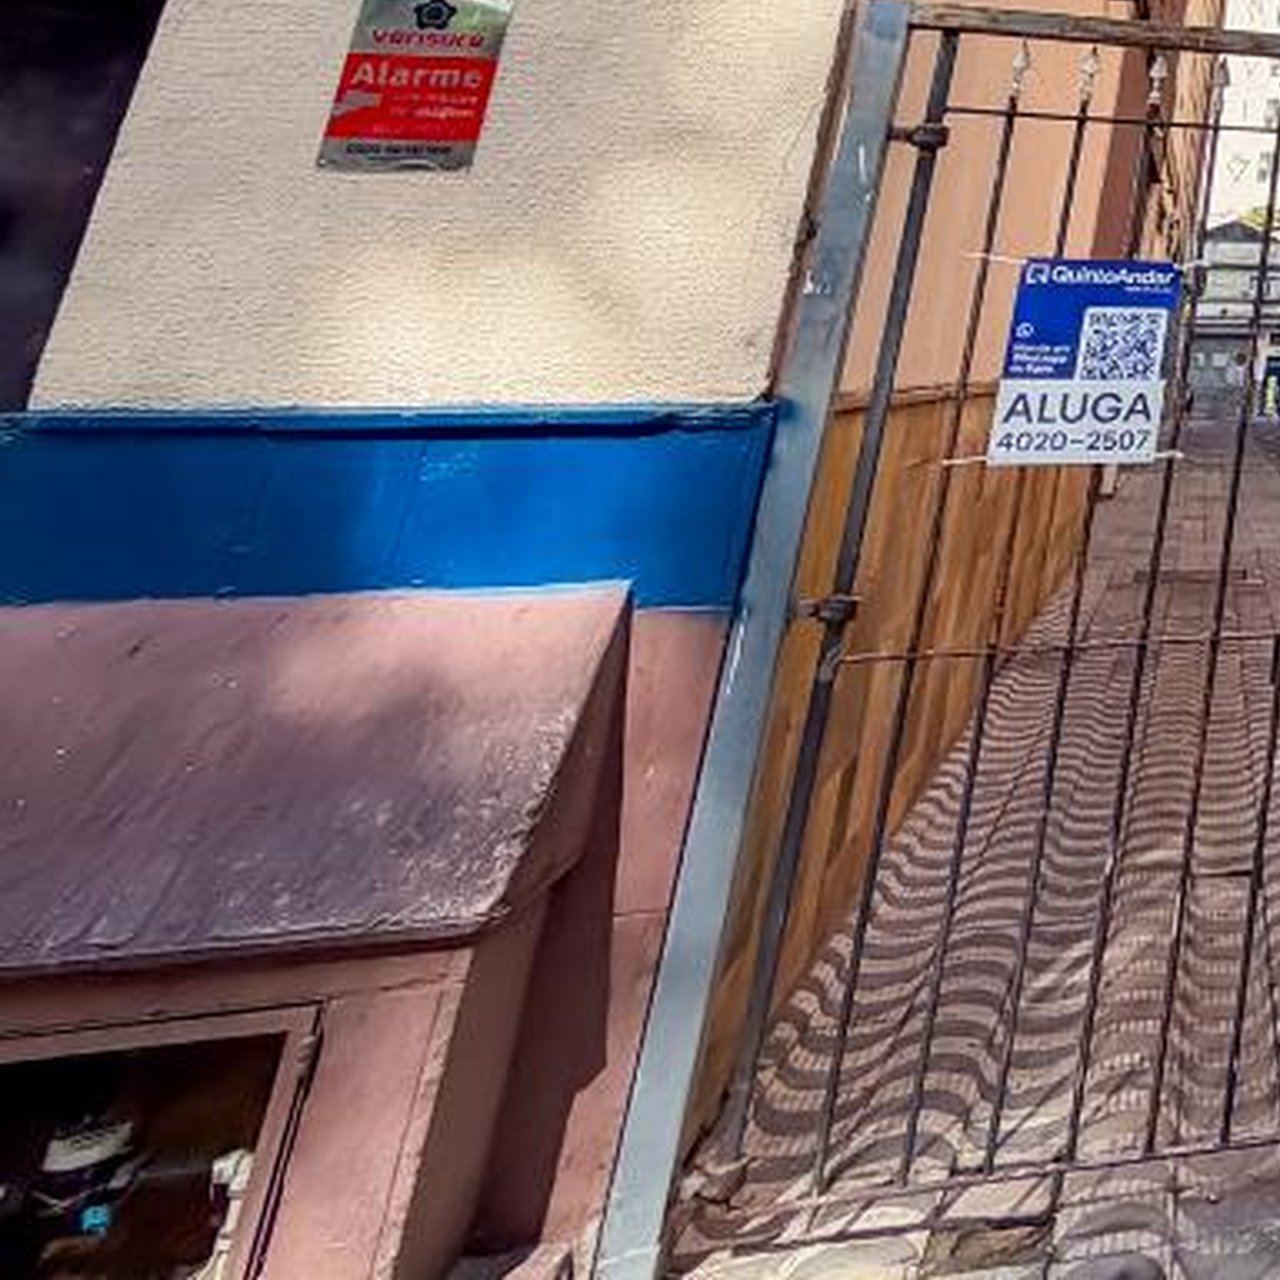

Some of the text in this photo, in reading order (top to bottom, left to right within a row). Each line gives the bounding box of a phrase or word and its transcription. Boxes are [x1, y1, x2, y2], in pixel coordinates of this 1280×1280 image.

[350, 61, 481, 88] Alarme
[1052, 265, 1175, 284] QuintoAndar
[1002, 392, 1152, 423] ALUGA
[996, 429, 1151, 452] 4020-2507
